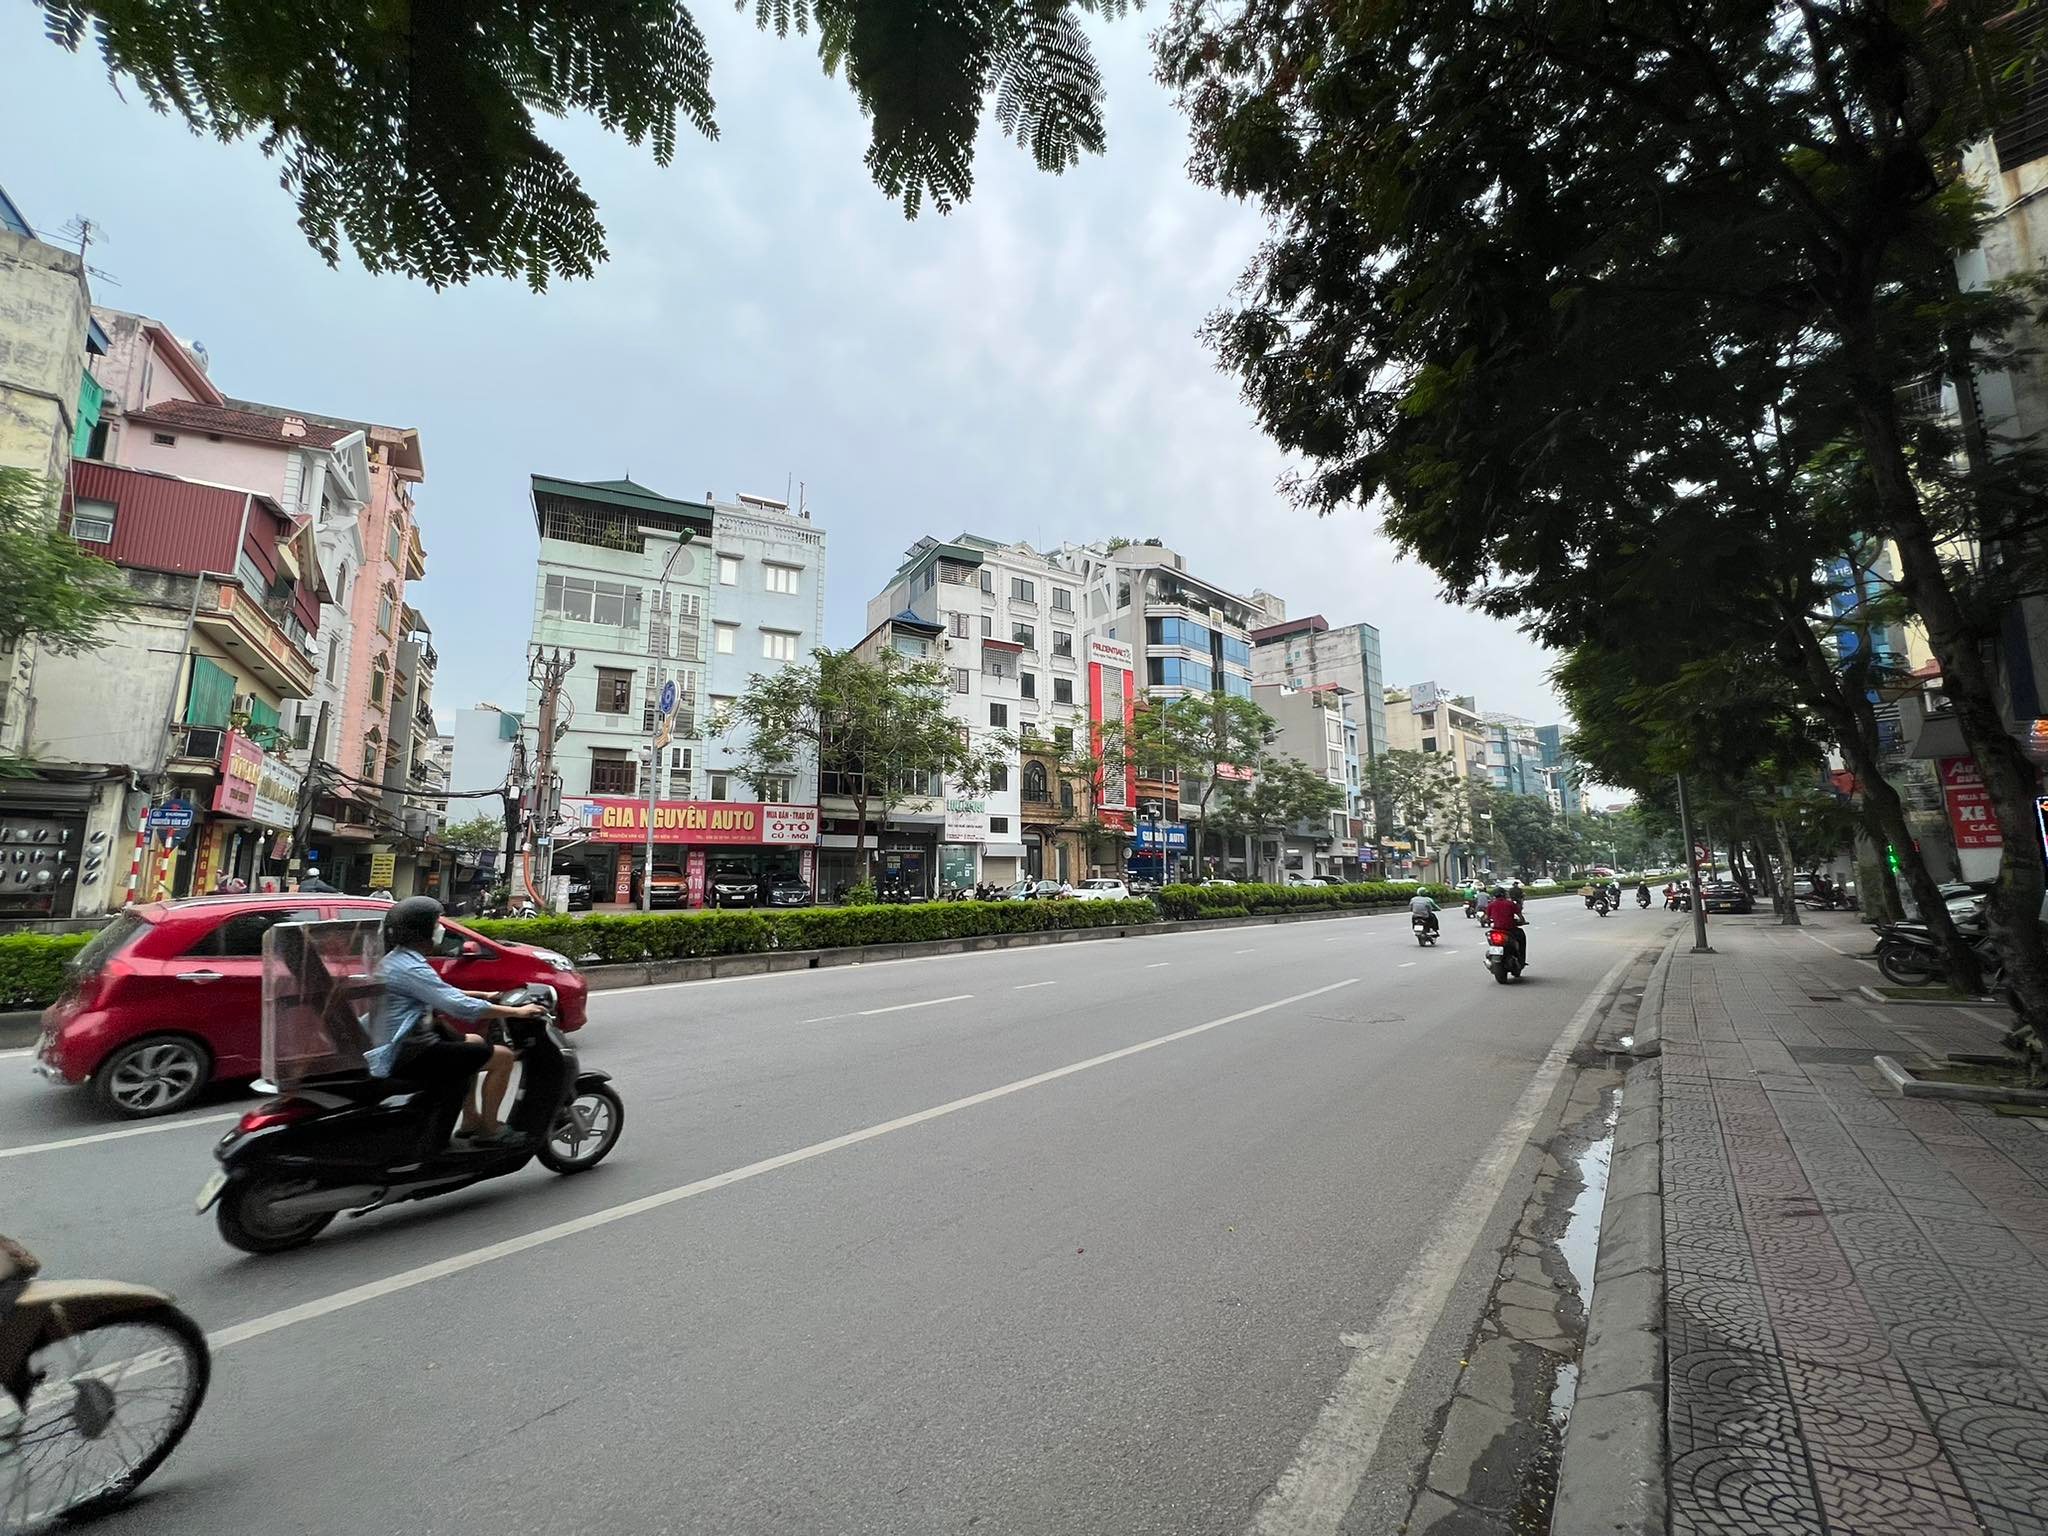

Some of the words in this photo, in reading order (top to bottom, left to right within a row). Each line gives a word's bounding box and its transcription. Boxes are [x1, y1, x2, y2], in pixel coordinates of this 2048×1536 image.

[1093, 641, 1123, 656] PRUDENTIAL
[603, 806, 635, 828] GIA
[639, 805, 708, 829] NGUYÊN
[711, 810, 755, 831] AUTO
[1958, 806, 1987, 821] XE
[1168, 832, 1185, 844] AUTO
